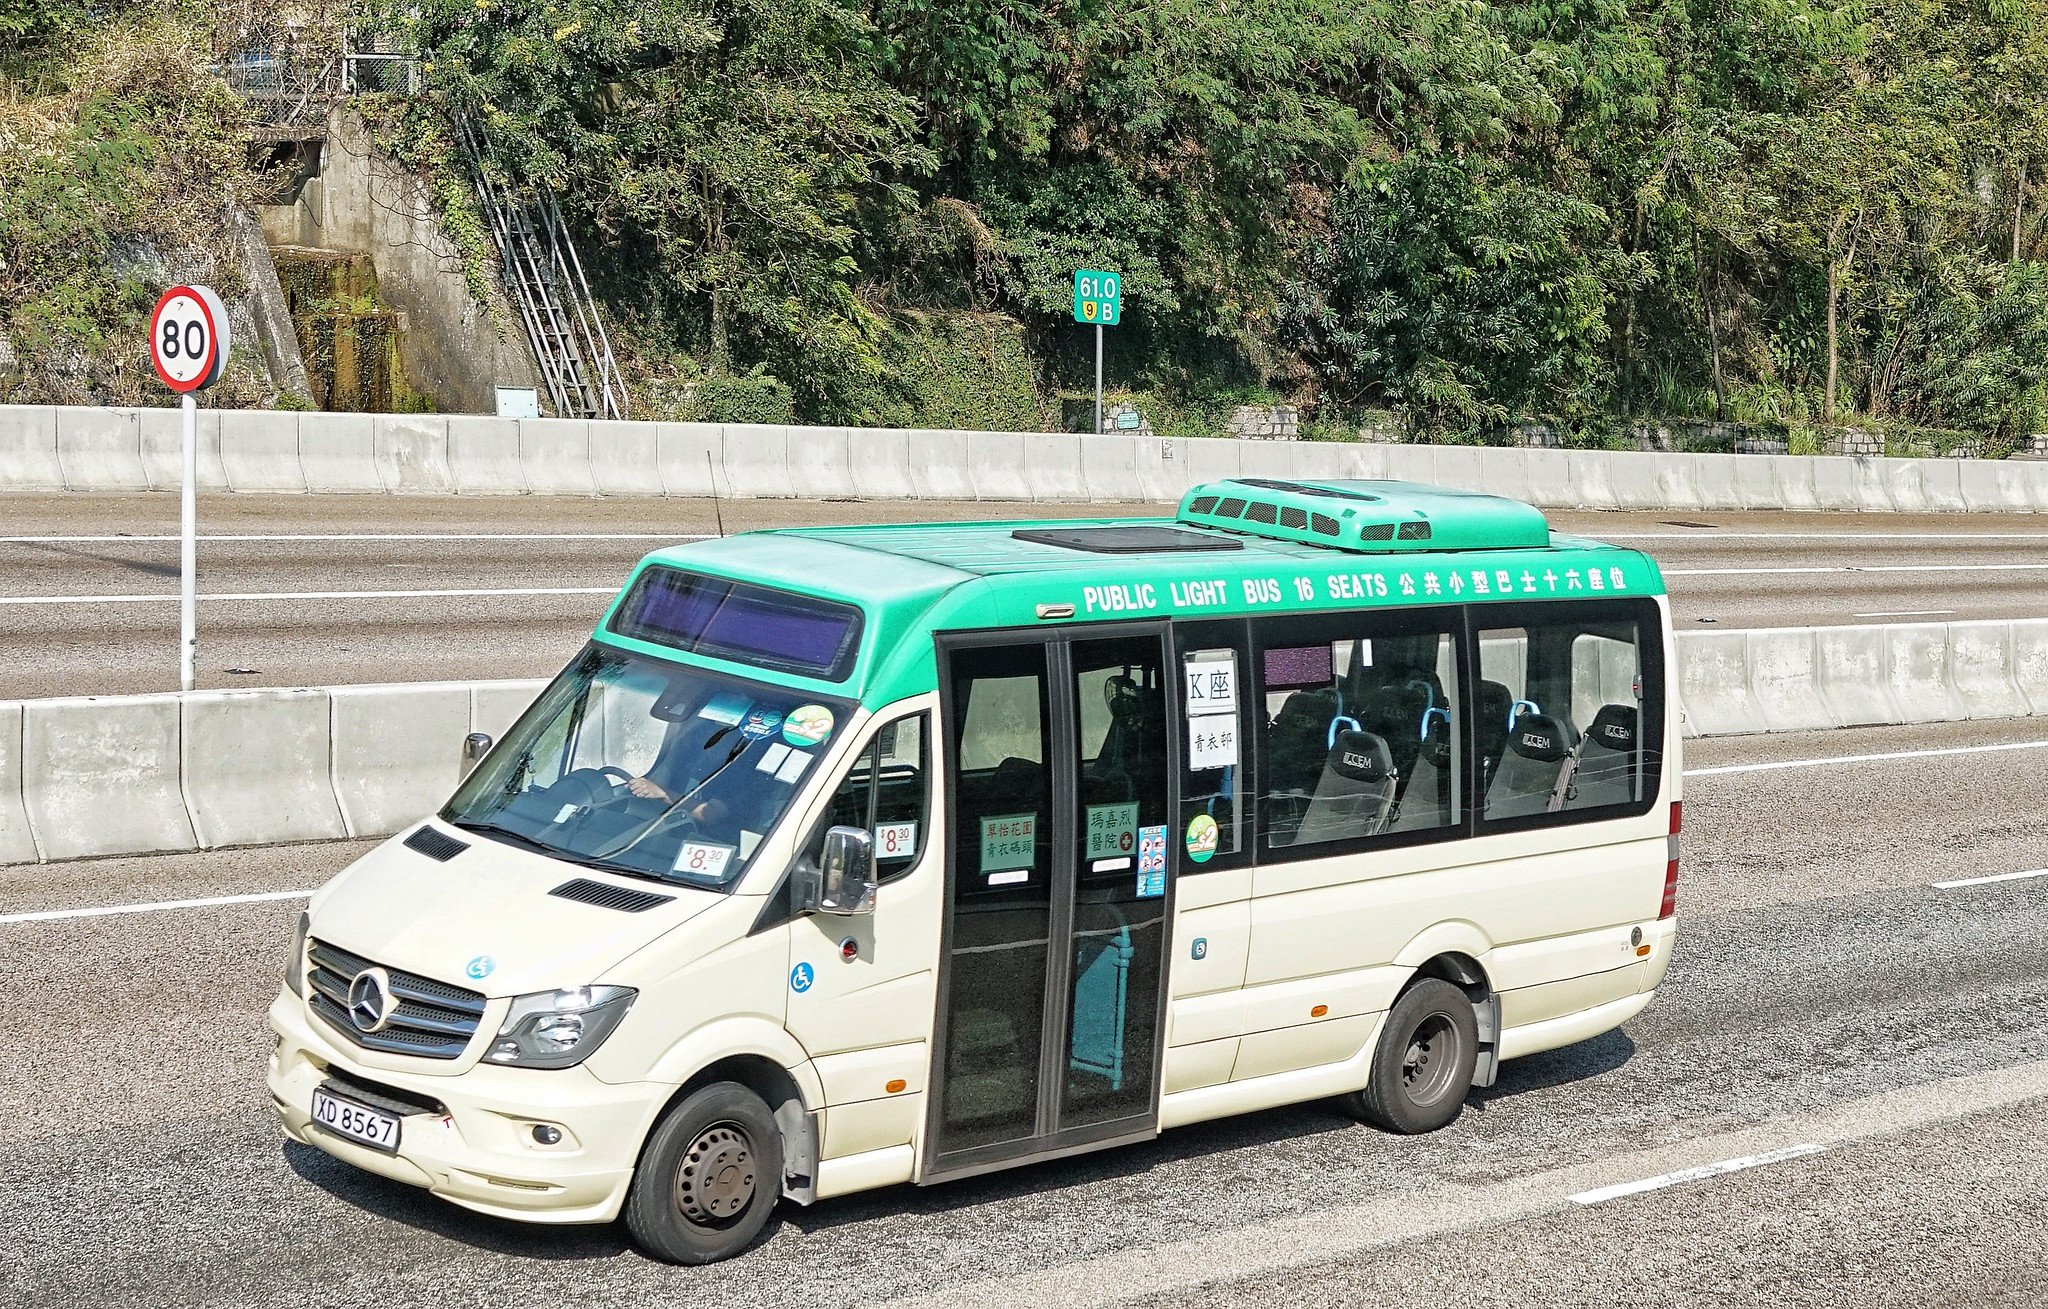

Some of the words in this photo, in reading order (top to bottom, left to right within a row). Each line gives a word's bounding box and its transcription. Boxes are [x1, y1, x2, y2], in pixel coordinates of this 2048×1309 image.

[1080, 276, 1116, 299] 61.0
[1086, 303, 1094, 316] 9
[1102, 302, 1113, 321] B
[162, 319, 206, 360] 80
[1083, 583, 1157, 612] PUBLIC
[1170, 579, 1227, 607] LIGHT
[1242, 578, 1282, 604] BUS
[1293, 576, 1314, 602] 16
[1327, 573, 1388, 600] SEATS
[1092, 833, 1118, 852] 醫院
[316, 1095, 337, 1124] XD
[341, 1107, 394, 1143] 8567
